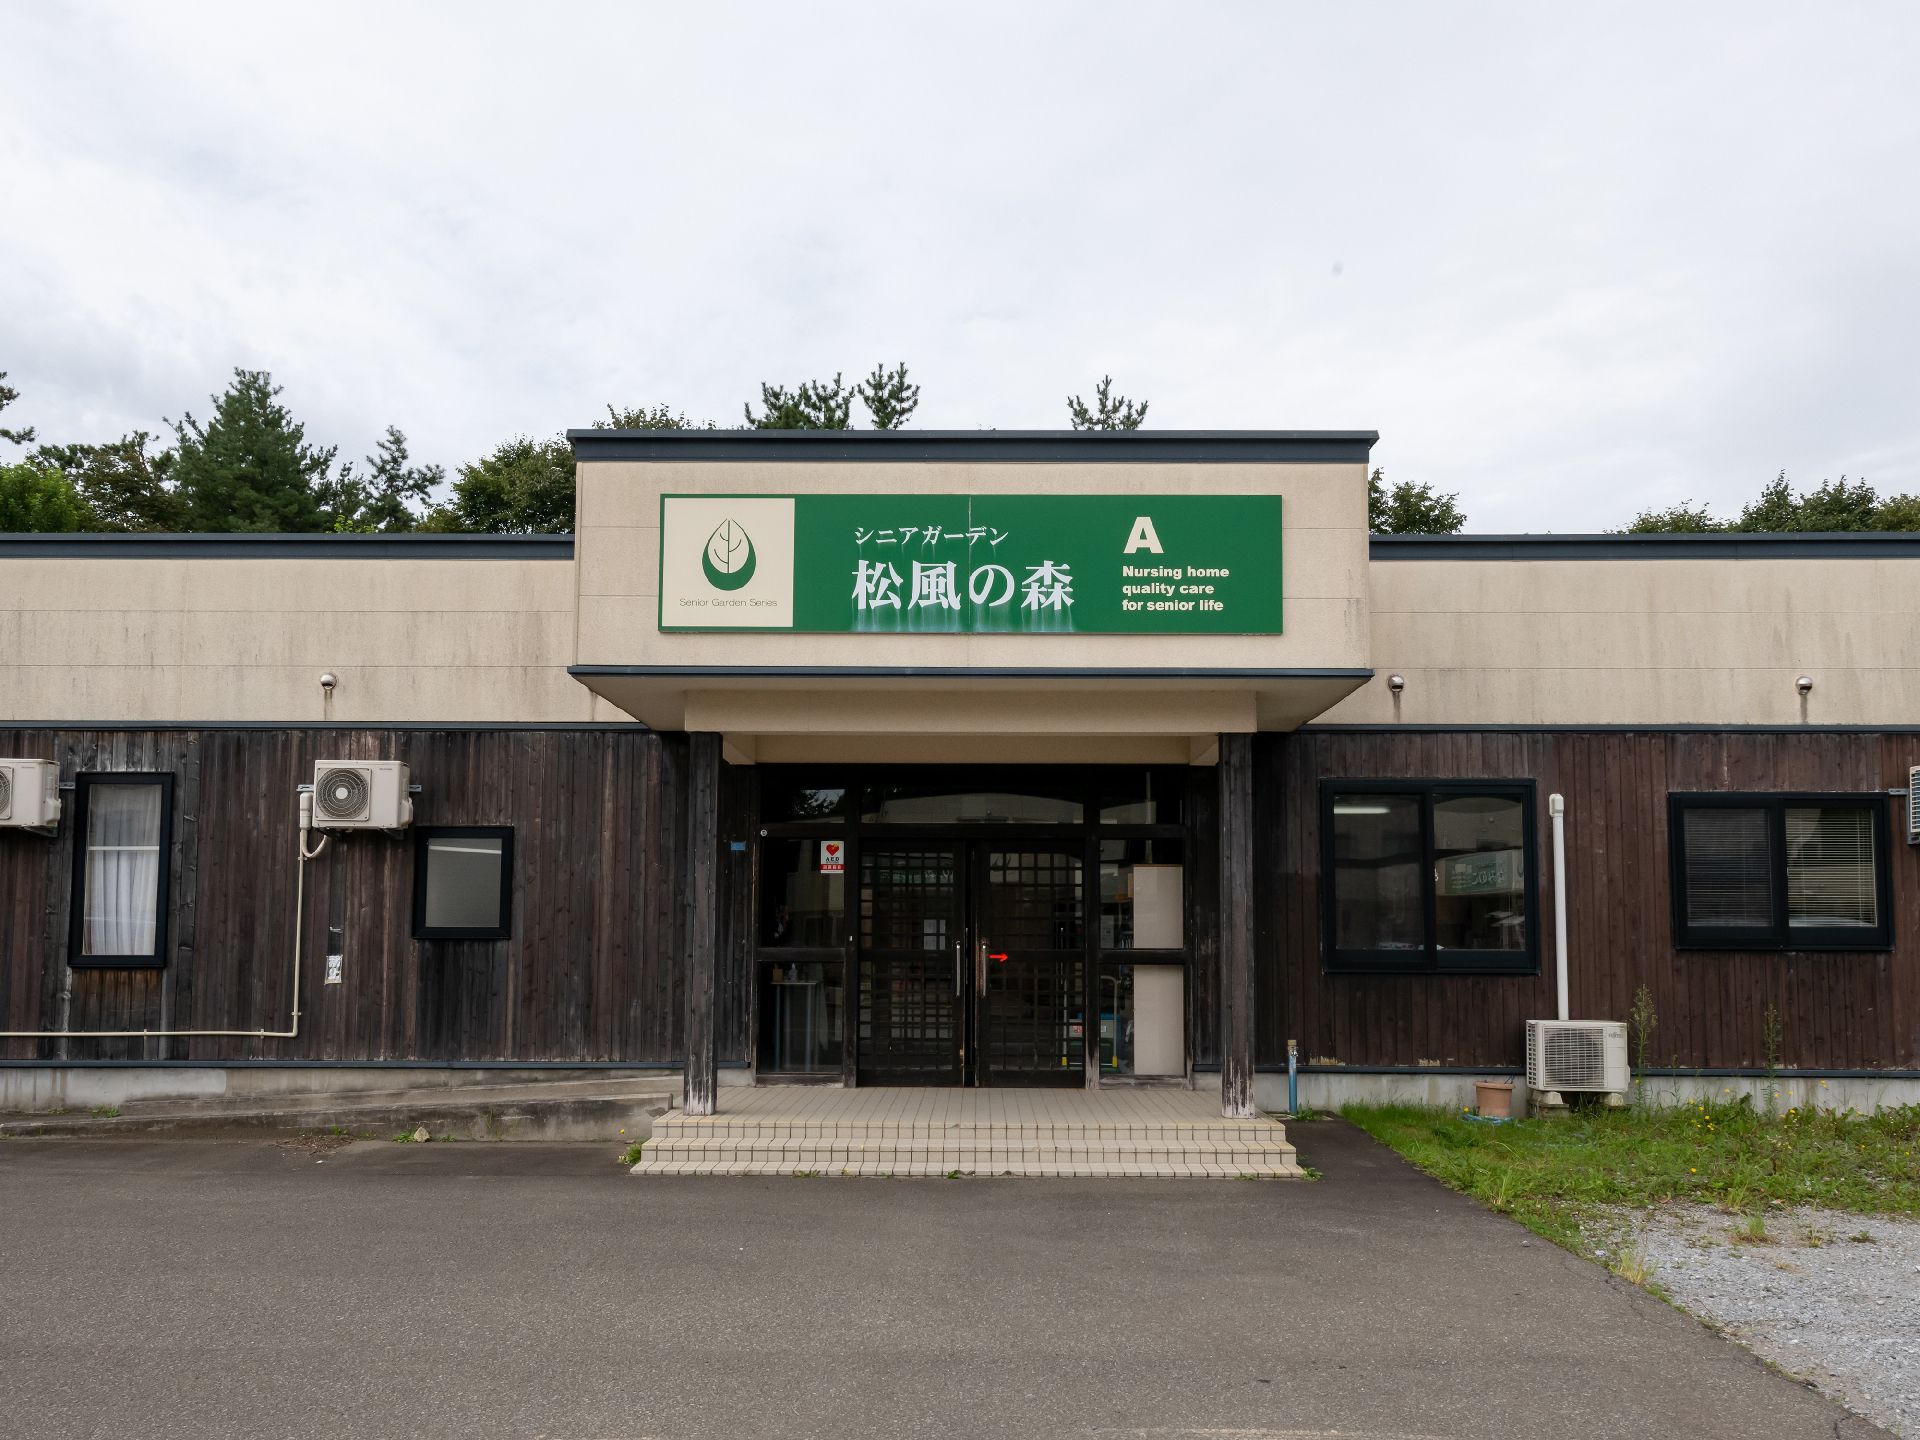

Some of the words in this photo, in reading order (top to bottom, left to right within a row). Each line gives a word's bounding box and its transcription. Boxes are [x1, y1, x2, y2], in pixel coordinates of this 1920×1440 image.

[854, 525, 1009, 546] シニアガーデン
[1123, 516, 1165, 554] A
[1122, 565, 1183, 580] Nursing
[1187, 565, 1230, 577] home
[851, 559, 1075, 611] 松風の森
[1122, 582, 1176, 597] quality
[1179, 585, 1215, 594] care
[679, 598, 709, 607] Senior
[711, 598, 747, 607] Garden
[749, 598, 778, 607] Series
[1121, 599, 1144, 611] for
[1146, 599, 1196, 611] senior
[1199, 599, 1224, 611] life
